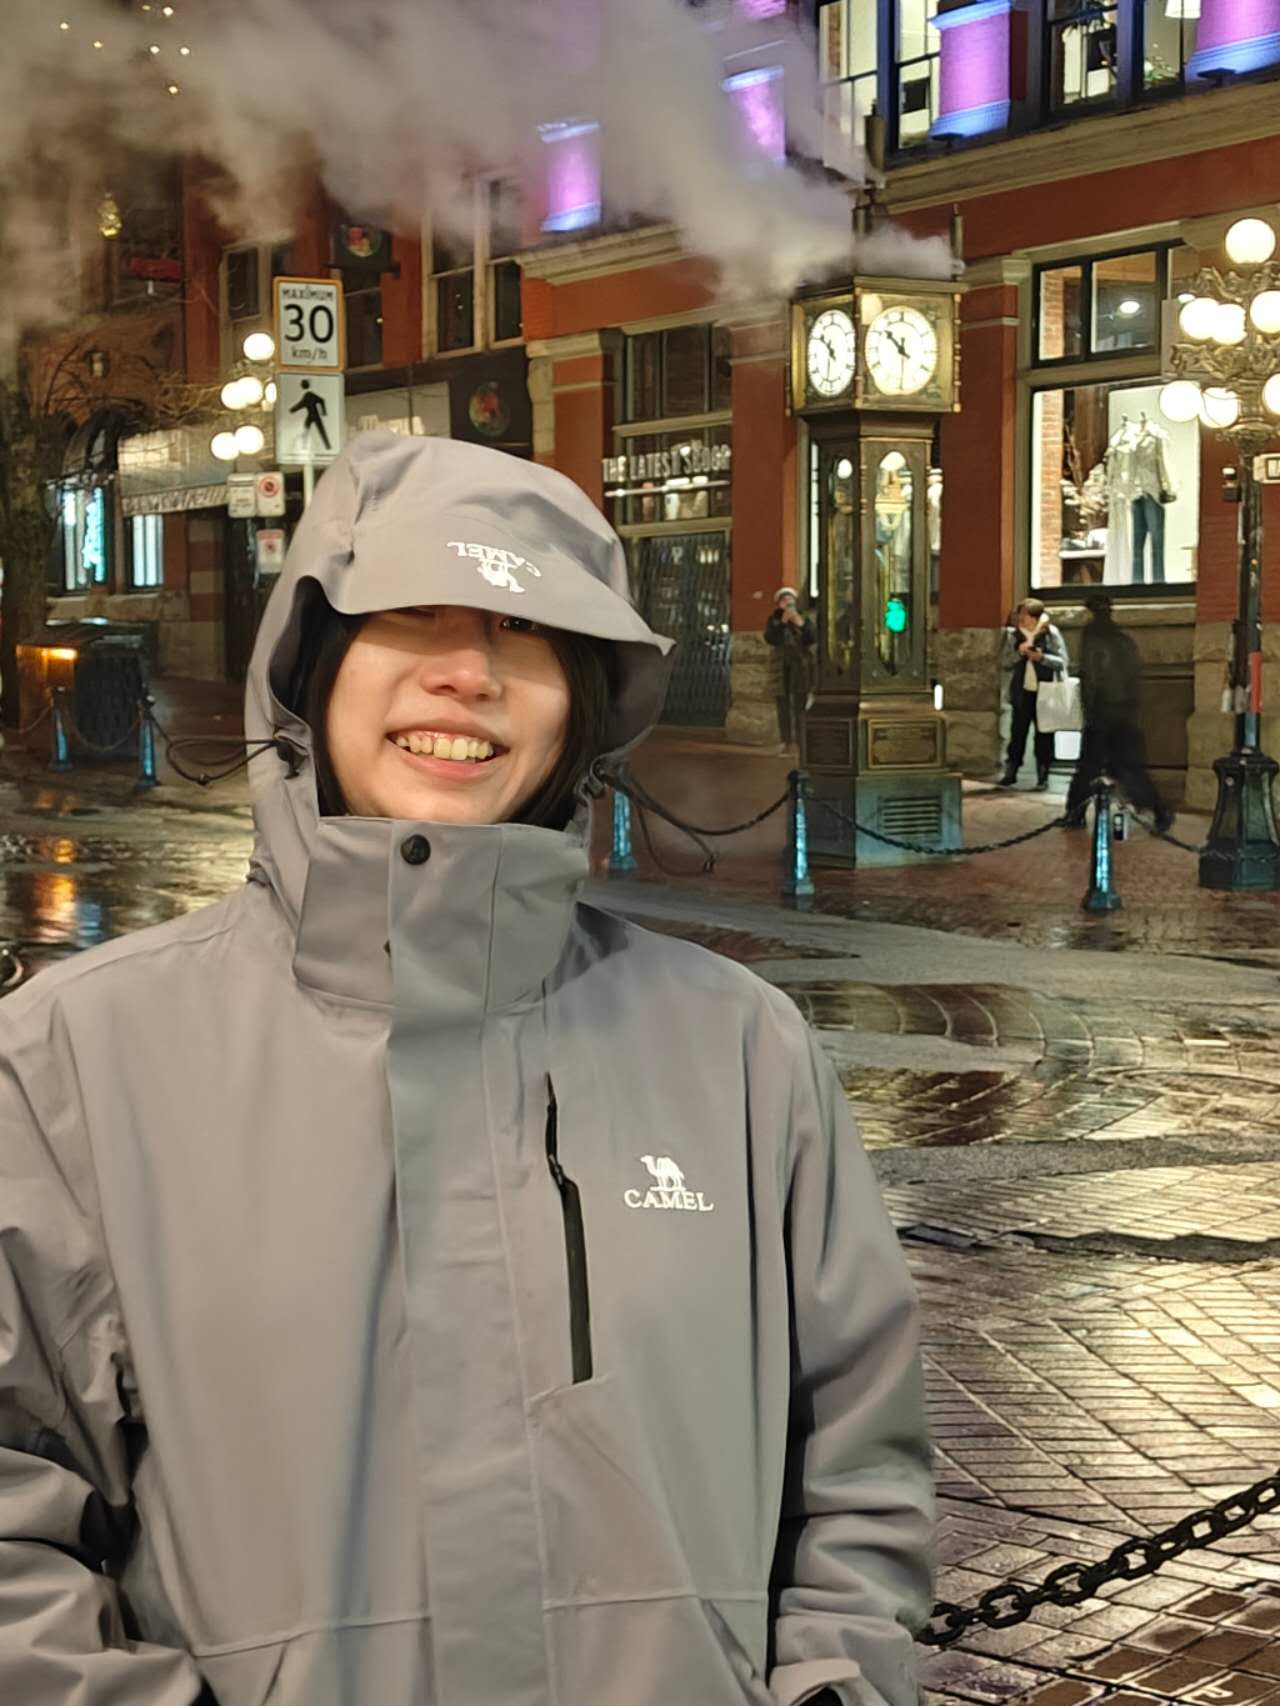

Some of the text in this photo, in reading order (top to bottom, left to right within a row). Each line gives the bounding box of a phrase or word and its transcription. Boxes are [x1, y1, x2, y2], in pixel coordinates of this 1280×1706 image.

[284, 303, 334, 344] 30
[291, 345, 328, 361] km/h
[602, 455, 626, 482] THE
[630, 449, 681, 480] LATEST
[447, 542, 542, 577] CAMEL
[624, 1189, 714, 1211] CAMEL
